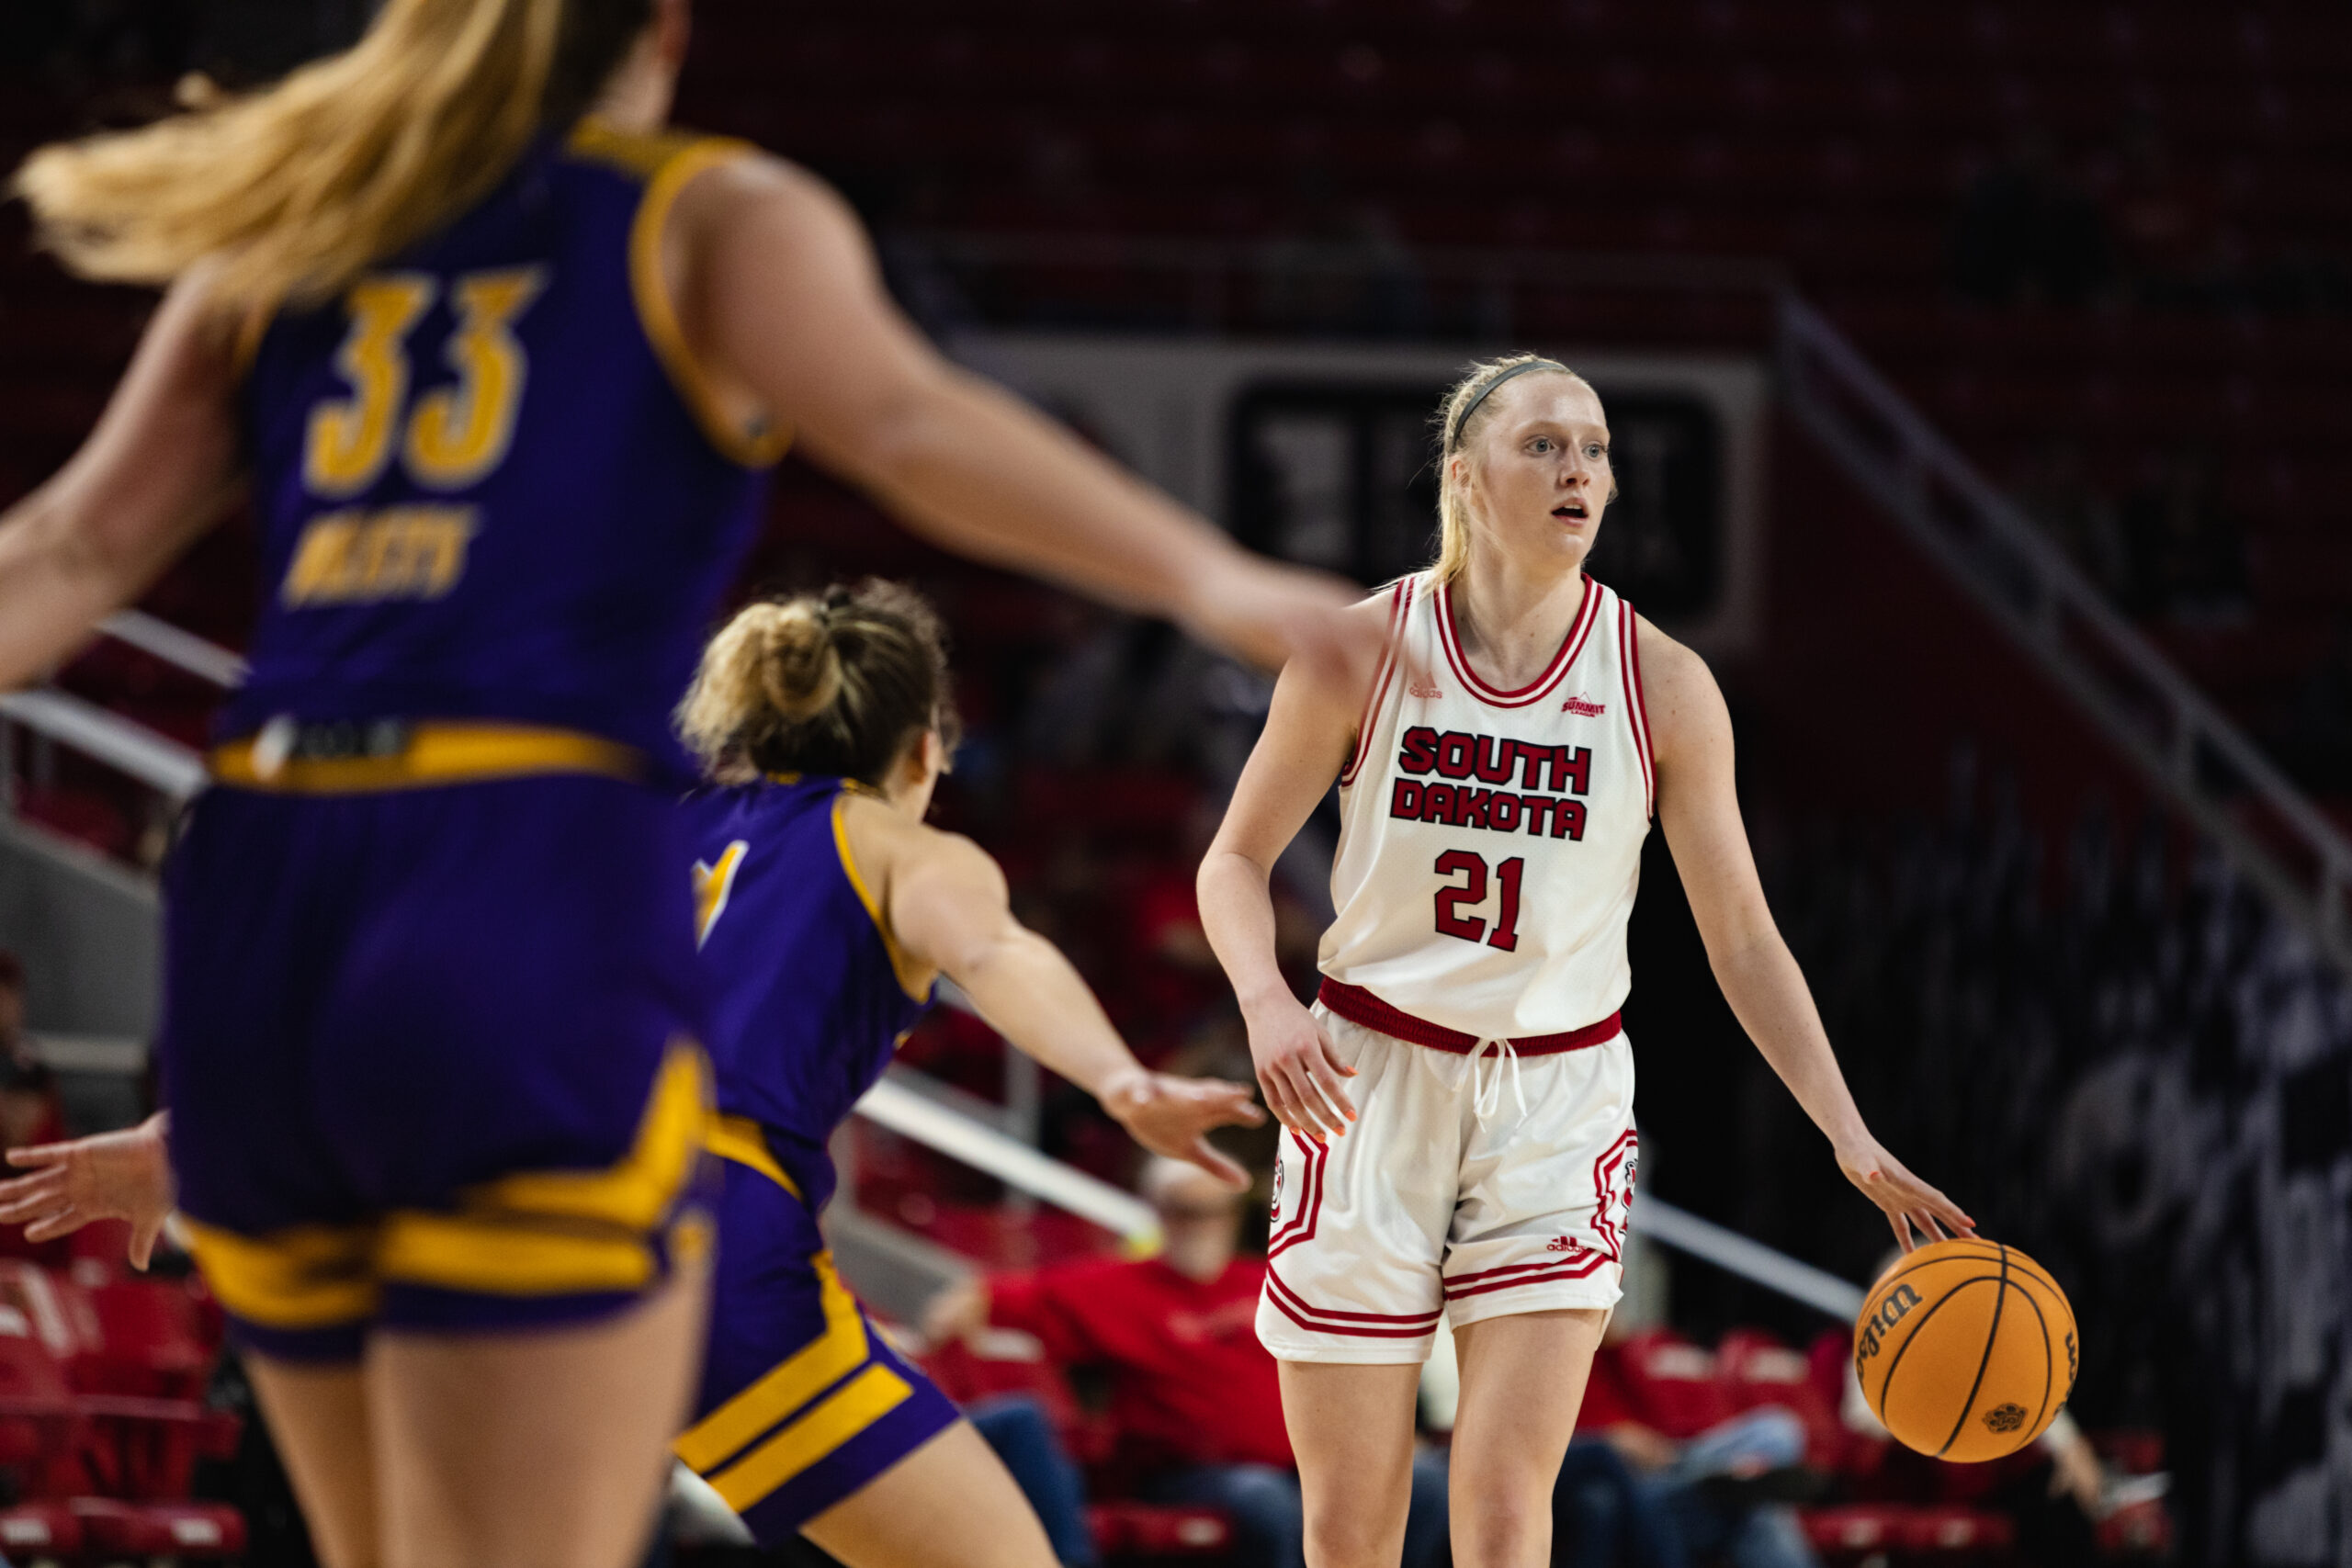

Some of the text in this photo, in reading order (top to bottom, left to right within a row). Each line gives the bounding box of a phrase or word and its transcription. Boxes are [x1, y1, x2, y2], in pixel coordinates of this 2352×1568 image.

[303, 263, 548, 500] 33
[1561, 700, 1606, 715] SUMMIT
[1398, 726, 1592, 796] SOUTH
[1389, 776, 1588, 842] DAKOTA
[1434, 849, 1525, 953] 21
[1855, 1283, 1924, 1387] Wilso
